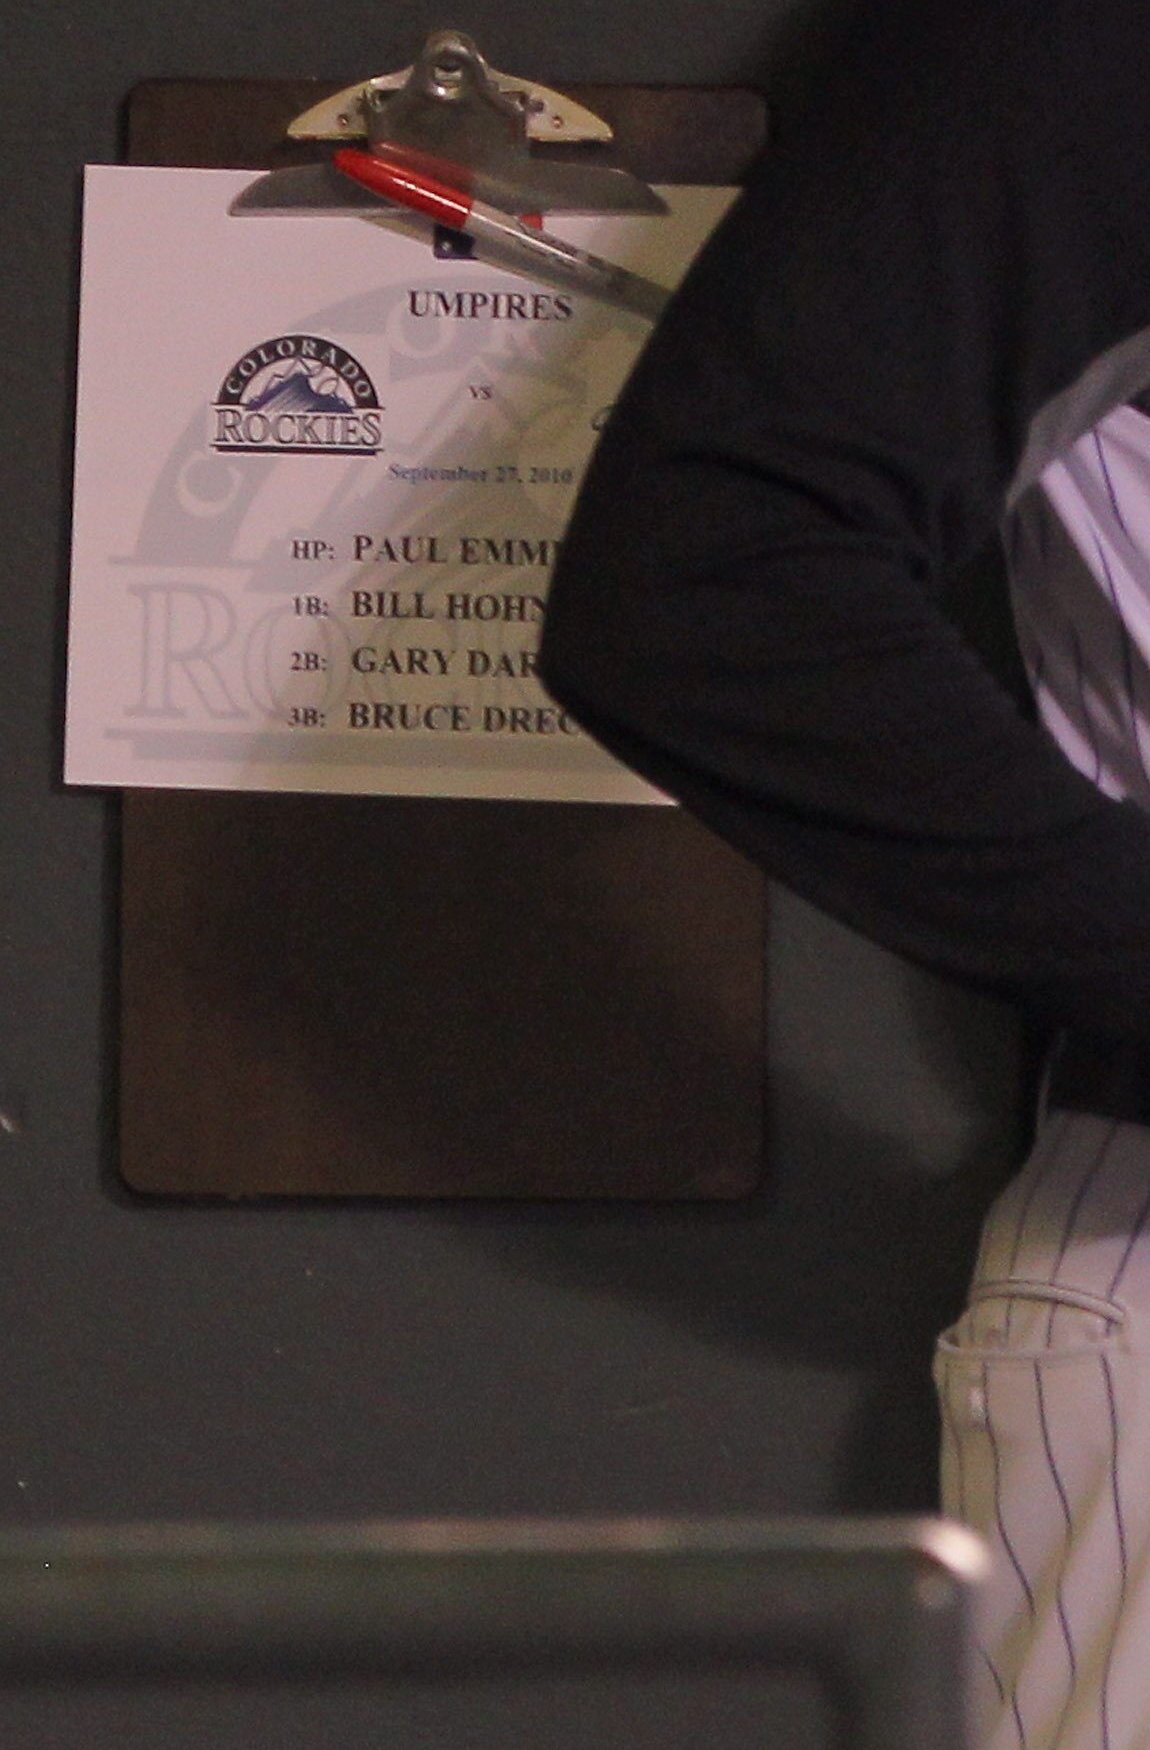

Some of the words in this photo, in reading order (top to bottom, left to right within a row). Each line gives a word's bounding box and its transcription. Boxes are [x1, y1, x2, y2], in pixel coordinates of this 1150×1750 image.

[408, 290, 575, 321] UMPIRES
[225, 338, 373, 398] COLORADO
[213, 408, 383, 447] ROCKIES
[388, 463, 489, 486] September
[530, 466, 573, 484] 2010
[291, 540, 335, 561] HP:
[352, 534, 447, 564] PAUL
[459, 537, 559, 566] EMM
[292, 596, 329, 617] 1B:
[351, 590, 435, 619] BILL
[290, 652, 328, 672] 2B:
[351, 646, 456, 676] GARY
[287, 707, 326, 729] 3B:
[348, 702, 473, 732] BRUCE
